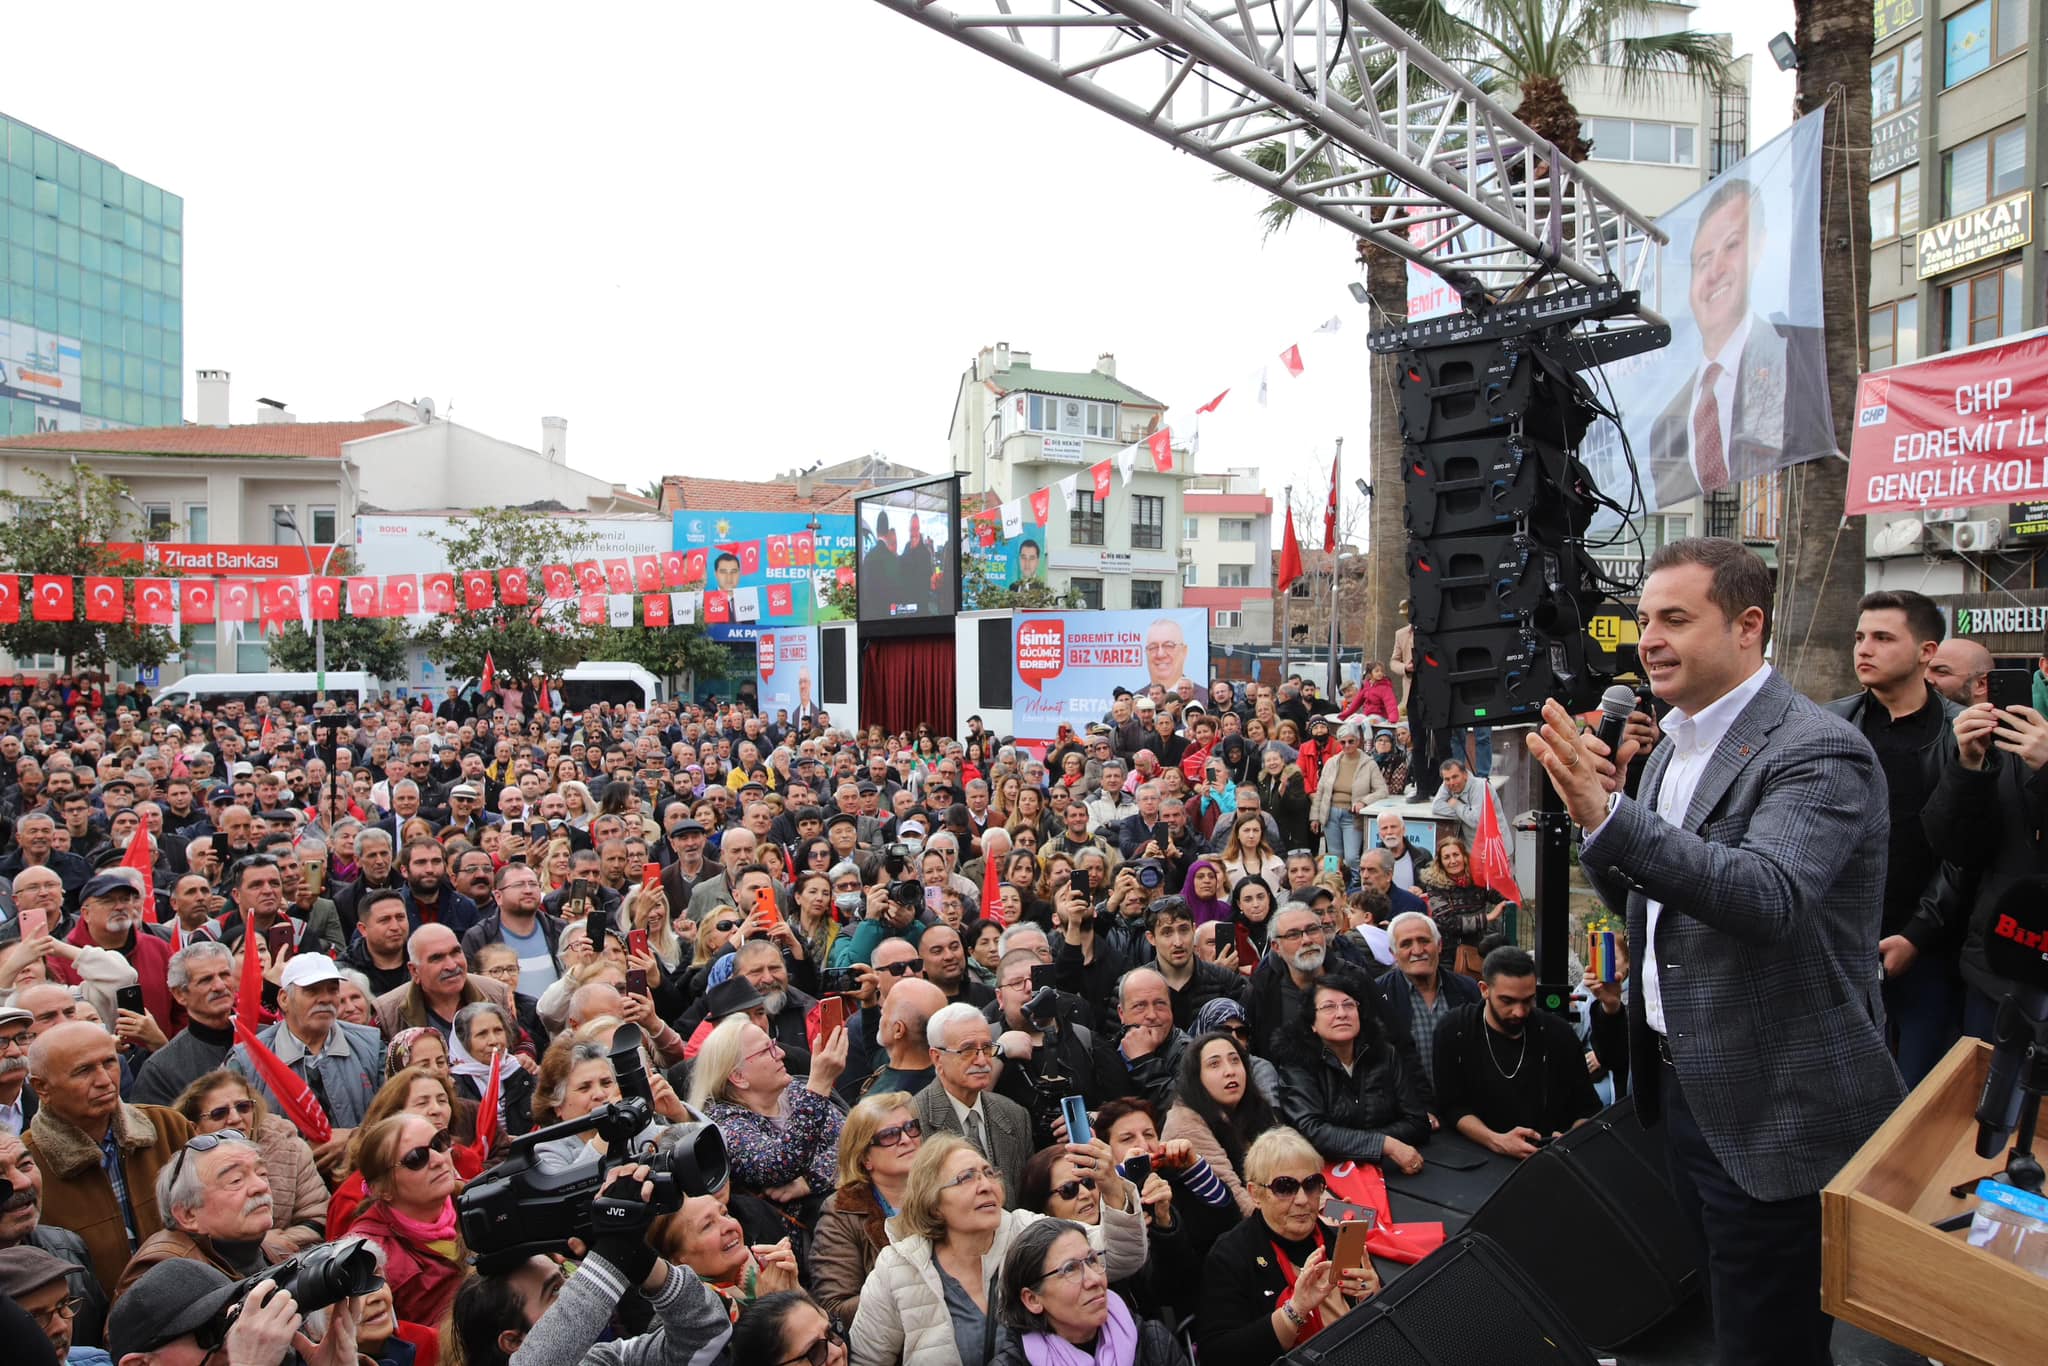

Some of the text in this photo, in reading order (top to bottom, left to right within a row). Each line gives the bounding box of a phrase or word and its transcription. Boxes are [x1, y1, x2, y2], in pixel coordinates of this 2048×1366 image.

[1920, 195, 2027, 255] AVUKAT
[1989, 222, 2019, 242] KARA
[1955, 377, 2013, 416] CHP
[1862, 407, 1885, 424] CHP
[1893, 414, 2013, 464] EDREMİT
[1867, 459, 1976, 506] GENÇLİK
[595, 541, 657, 554] teknolojiler.
[165, 551, 279, 569] Ziraat Bankası
[710, 605, 725, 613] CHP
[728, 629, 742, 637] AK
[1020, 629, 1061, 646] işimiz
[1068, 632, 1141, 644] EDREMİT İÇİN
[1019, 647, 1061, 657] GÜCÜMÜZ
[1094, 650, 1140, 663] VARIZ!
[1019, 659, 1061, 670] EDREMİT
[606, 1207, 625, 1217] JVC
